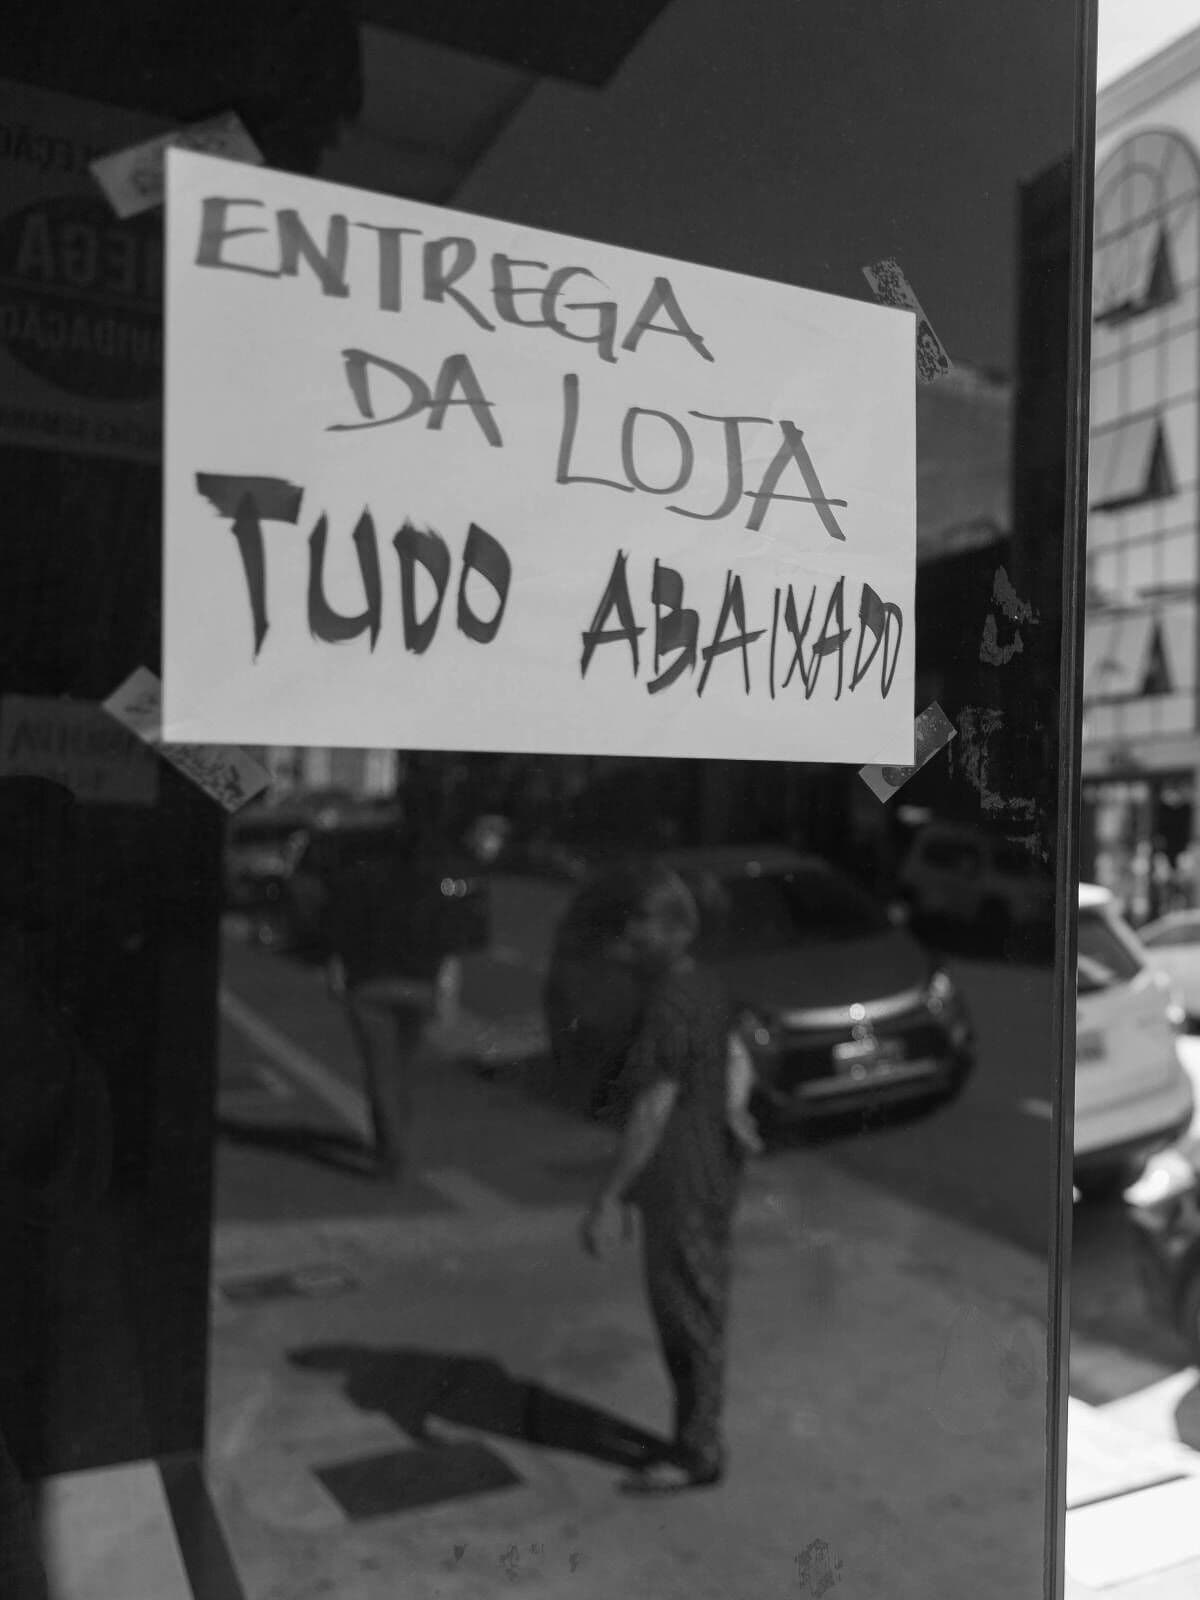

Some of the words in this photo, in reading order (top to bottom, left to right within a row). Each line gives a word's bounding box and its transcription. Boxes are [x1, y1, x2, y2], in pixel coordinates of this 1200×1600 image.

[194, 196, 714, 363] ENTREGA
[324, 347, 504, 448] DA
[556, 373, 848, 542] LOJA
[194, 471, 513, 663] TUDO
[580, 549, 904, 701] ABAIXADO
